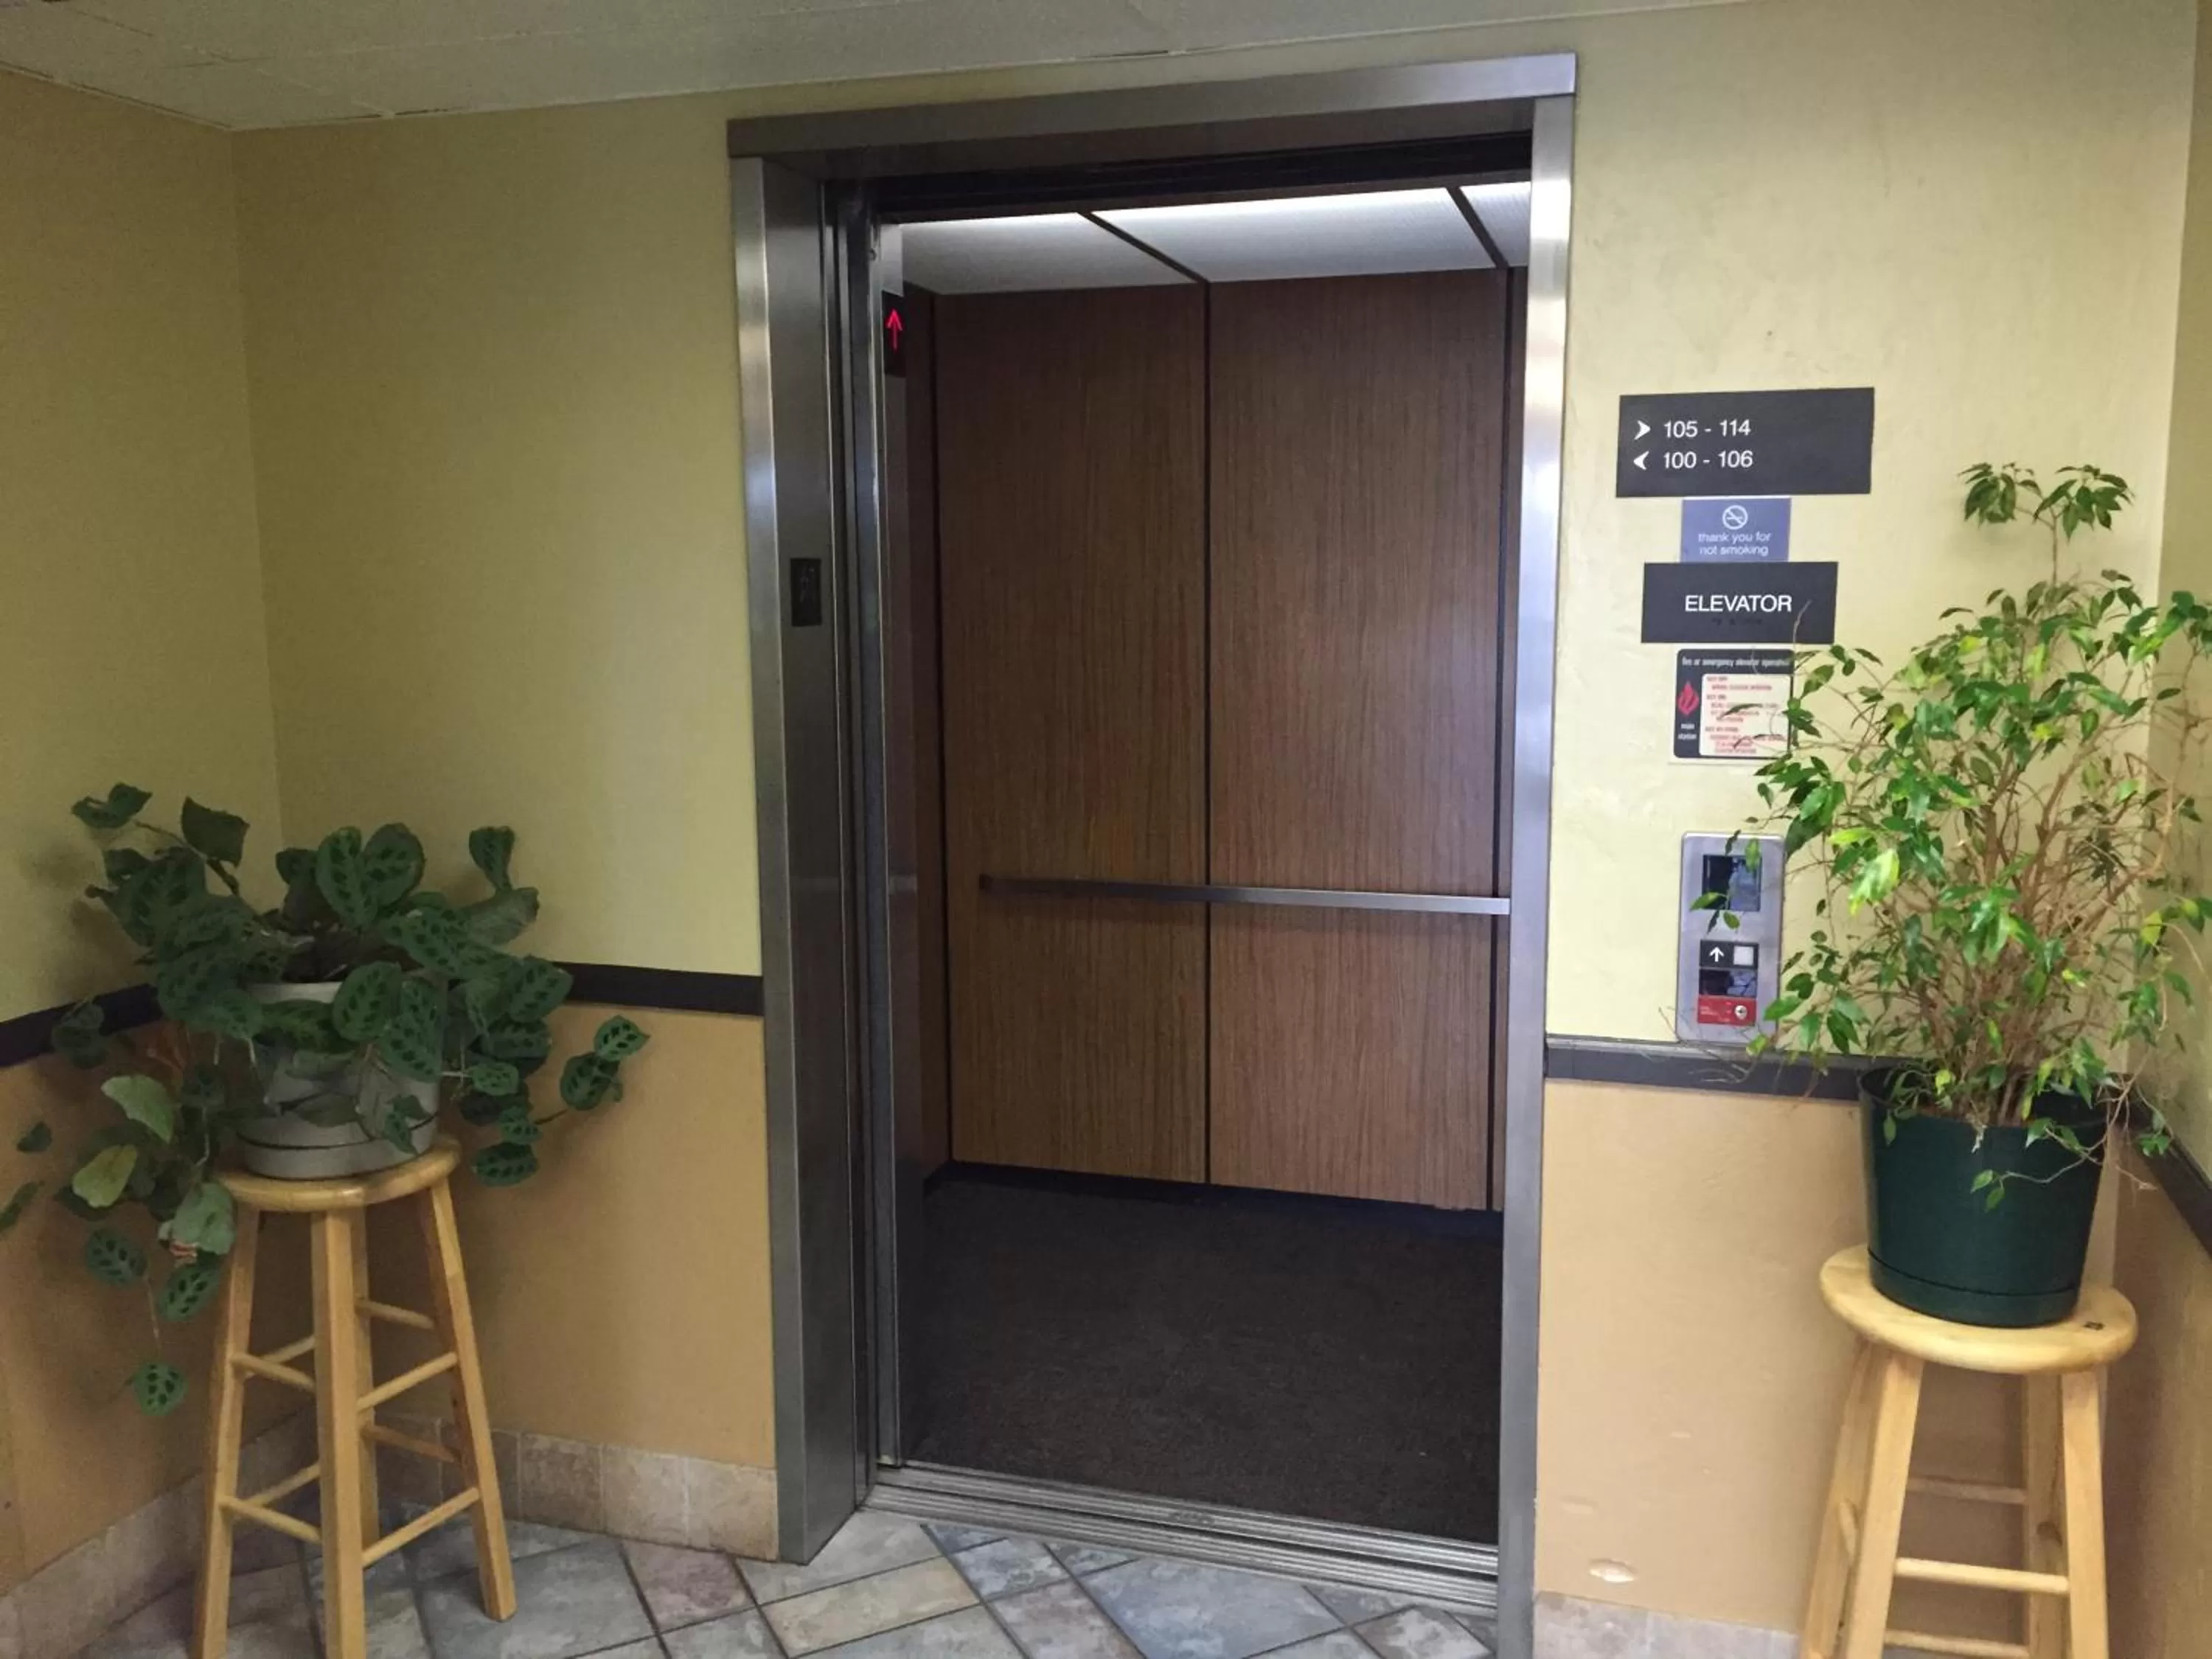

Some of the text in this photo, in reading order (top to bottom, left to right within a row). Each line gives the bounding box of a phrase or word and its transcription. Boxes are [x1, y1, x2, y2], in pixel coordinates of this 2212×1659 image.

[1663, 420, 1698, 439] 105
[1719, 419, 1751, 437] 114
[1663, 451, 1697, 469] 100
[1718, 451, 1753, 468] 106
[1698, 531, 1772, 544] thank you for
[1699, 544, 1769, 557] not smoking
[1684, 594, 1792, 612] ELEVATOR
